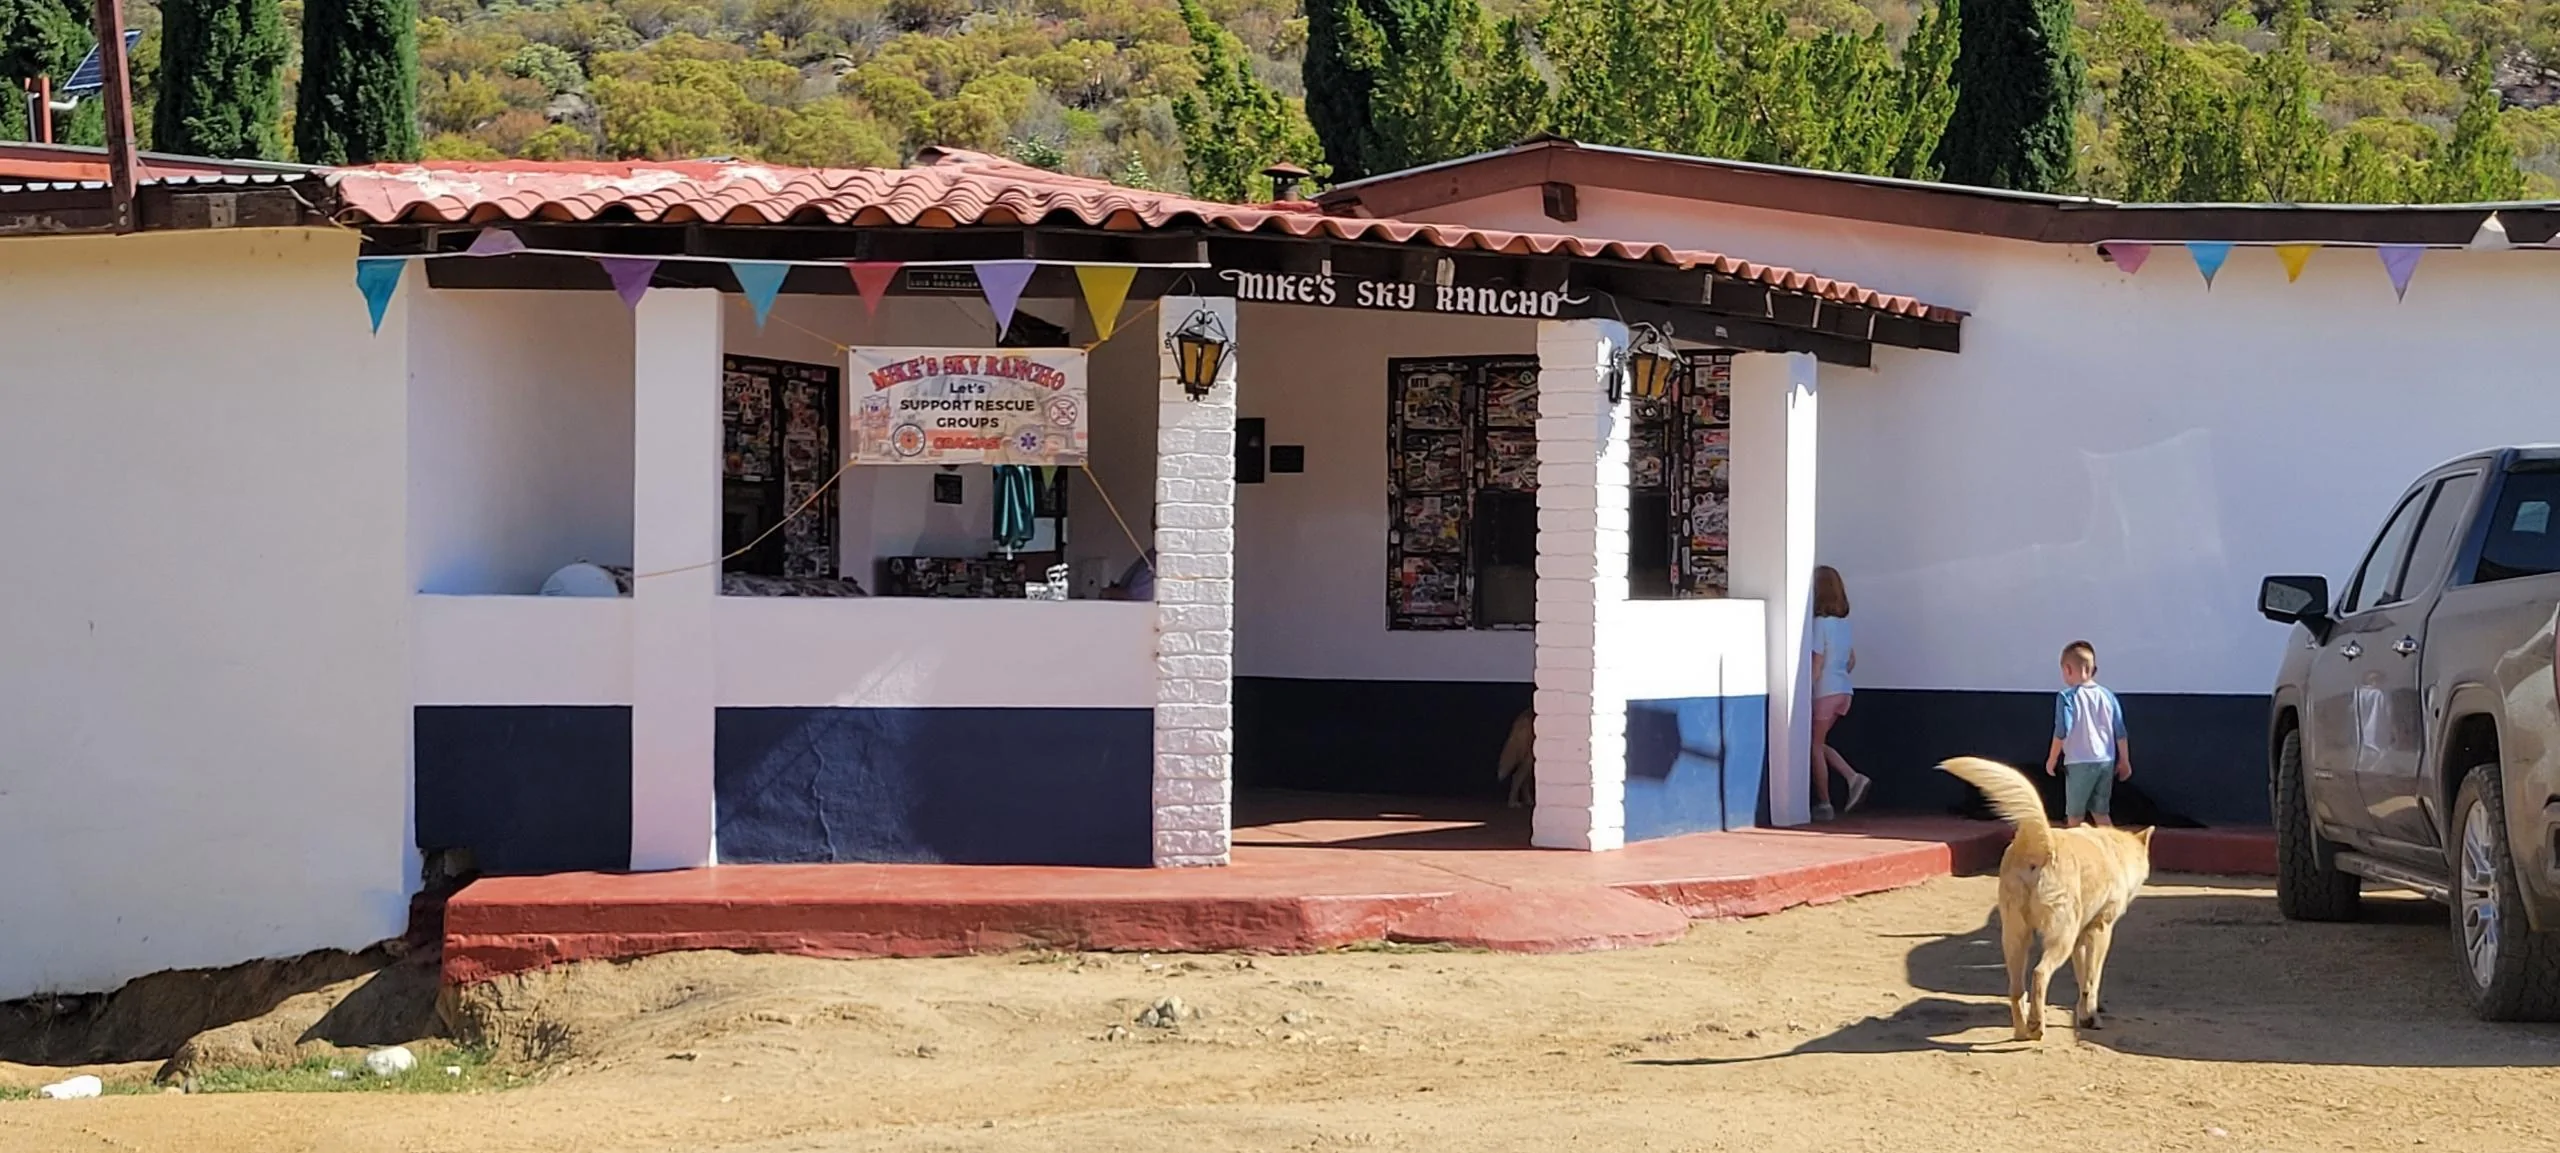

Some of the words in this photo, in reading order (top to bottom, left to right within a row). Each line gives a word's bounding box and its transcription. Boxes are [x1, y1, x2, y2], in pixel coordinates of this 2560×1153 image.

[1219, 269, 1336, 304] MIKE'S
[1357, 280, 1416, 310] SKY
[1436, 284, 1590, 317] RANCHO
[868, 355, 938, 391] MIKE'S
[943, 355, 982, 375] SKY
[984, 356, 1065, 391] RANCHO
[949, 382, 985, 395] Let's
[900, 399, 971, 412] SUPPORT
[974, 400, 1036, 412] RESCUE
[936, 417, 999, 429] GROUPS
